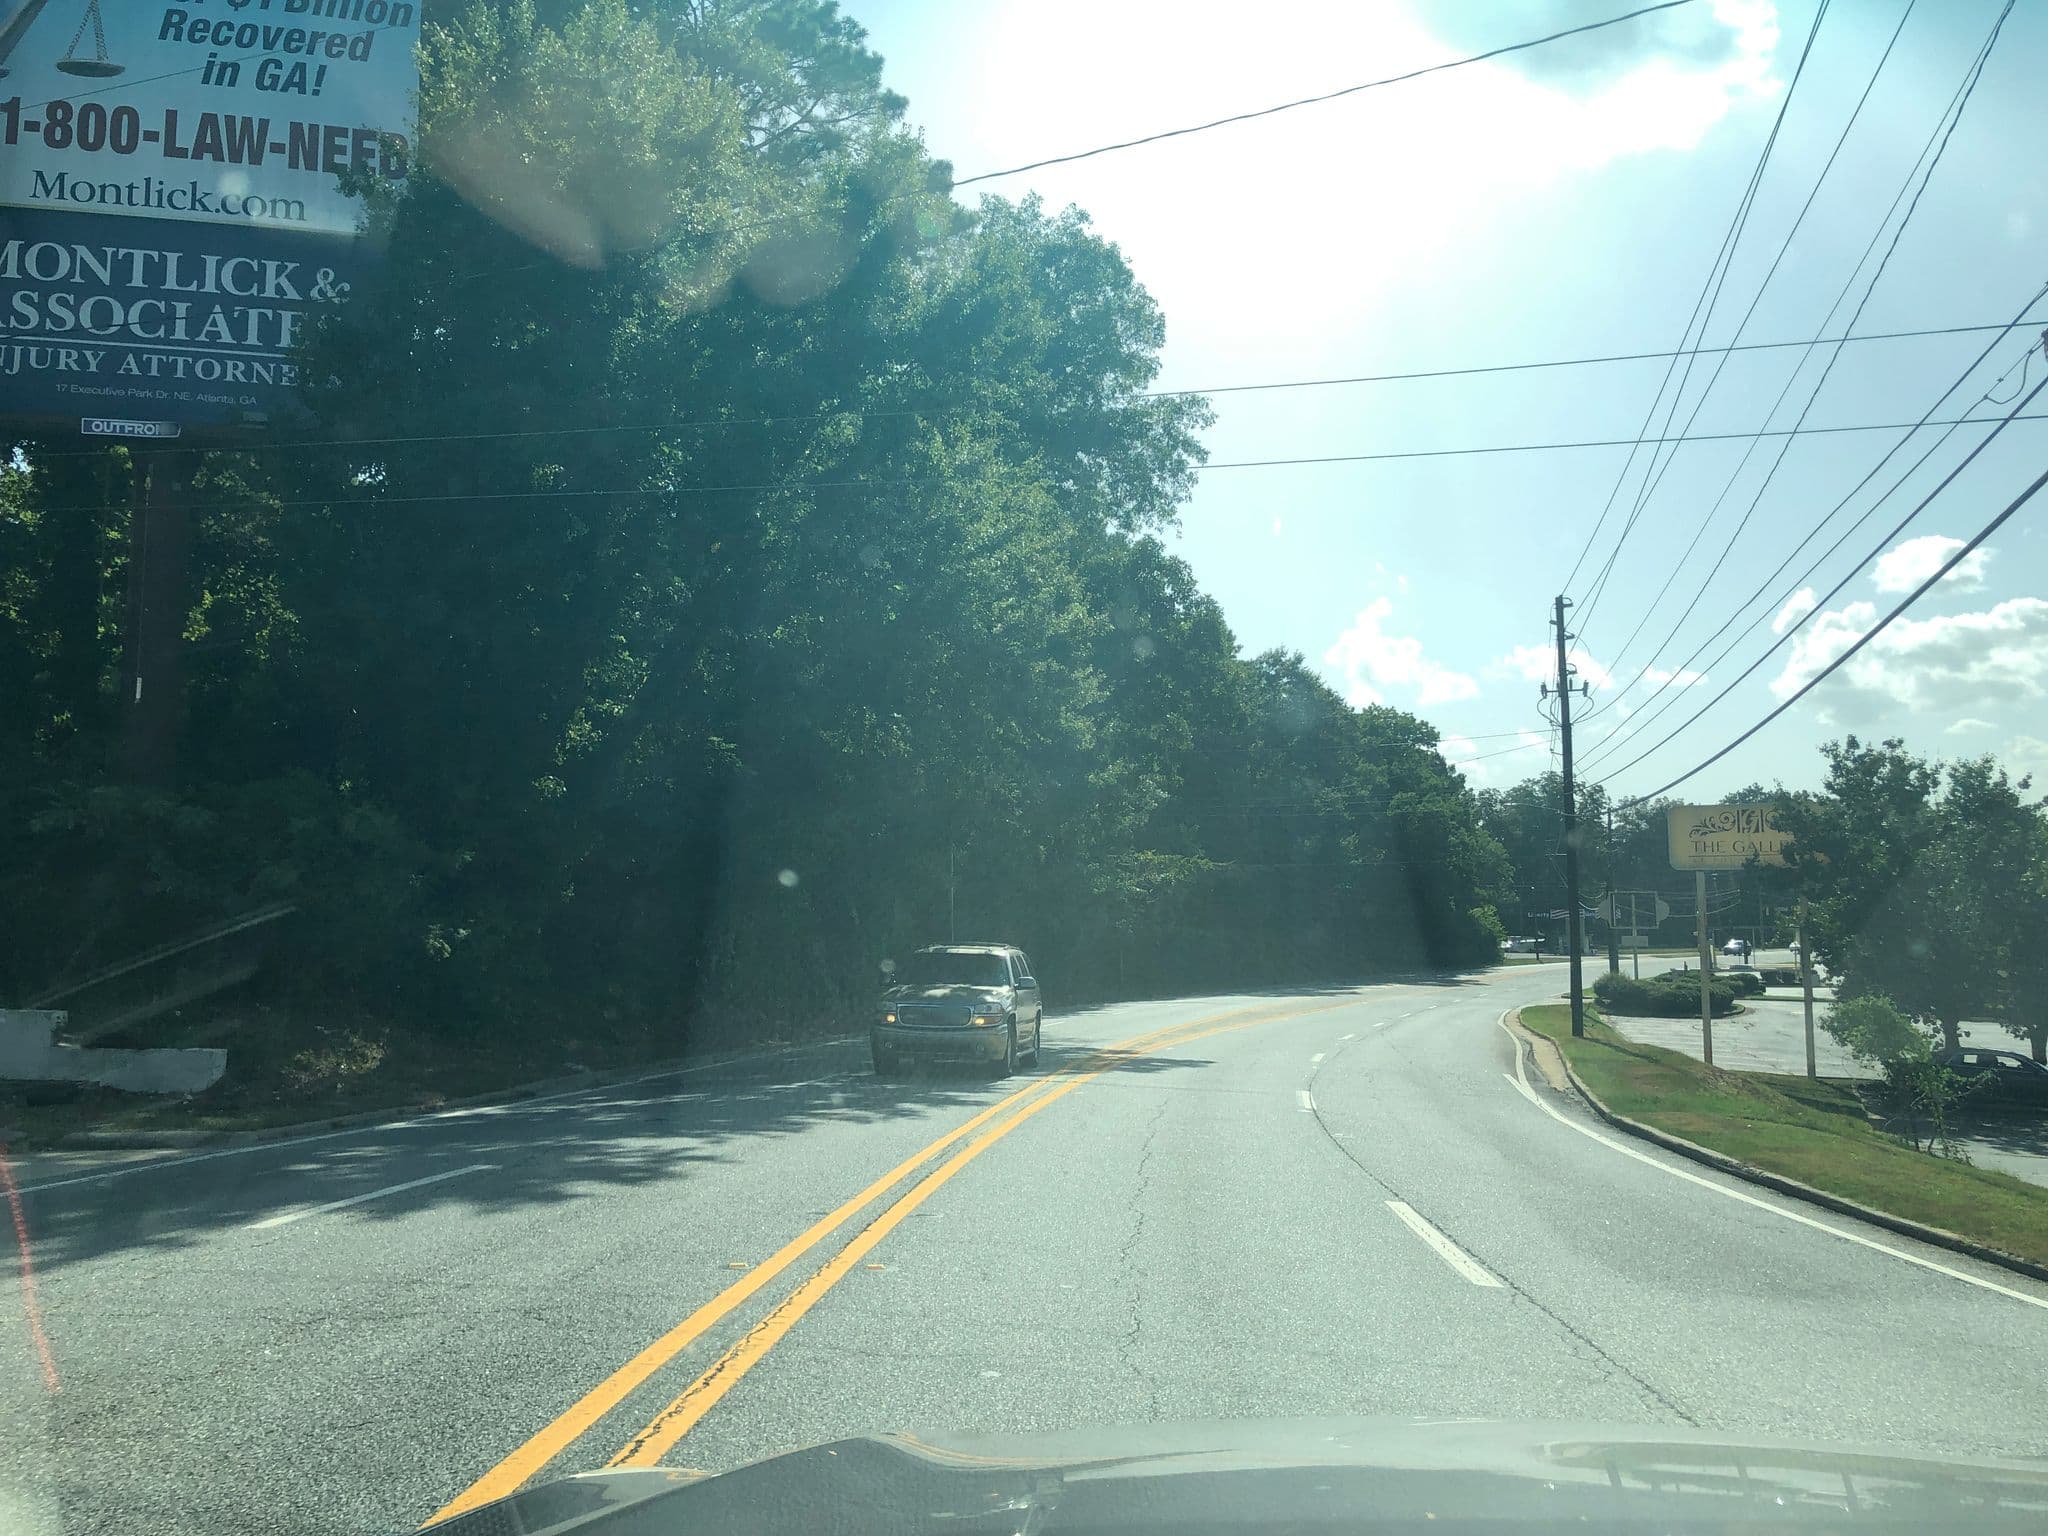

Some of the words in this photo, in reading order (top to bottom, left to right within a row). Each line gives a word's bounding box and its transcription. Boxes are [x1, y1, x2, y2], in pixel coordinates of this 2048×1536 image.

[158, 9, 375, 62] Recovered
[201, 53, 241, 88] in
[254, 58, 328, 96] GA!
[0, 96, 408, 180] 1-800-LAW-NEED
[29, 169, 307, 222] Montlick.com
[309, 267, 351, 303] &
[117, 352, 304, 386] ATTORNE
[56, 383, 67, 393] 17
[70, 384, 125, 396] Executive
[128, 388, 154, 399] Park
[239, 396, 257, 406] GA
[91, 420, 166, 436] OUTFRO
[1691, 841, 1726, 854] THE
